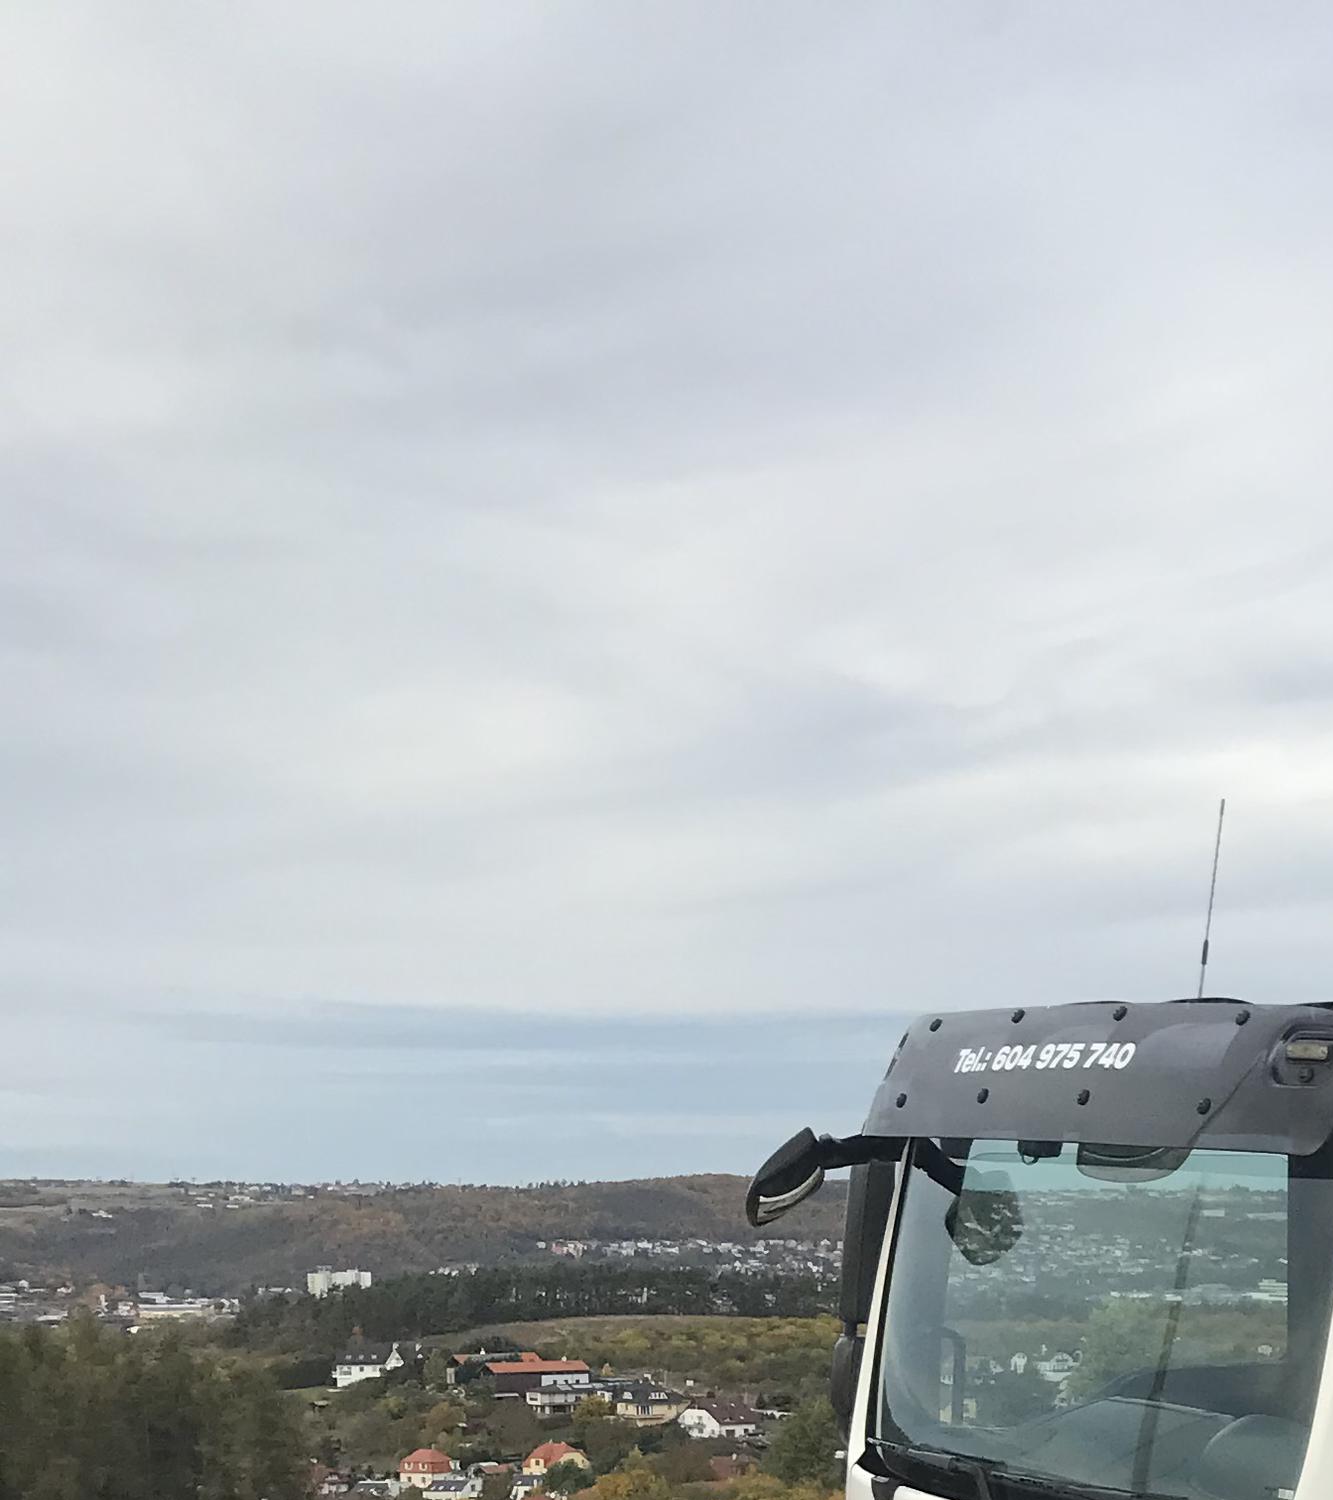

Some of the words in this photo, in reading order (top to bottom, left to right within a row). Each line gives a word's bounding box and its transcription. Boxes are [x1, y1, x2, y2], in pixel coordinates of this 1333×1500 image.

[954, 1046, 993, 1073] Tel.:
[991, 1044, 1037, 1071] 604
[1035, 1043, 1086, 1070] 975
[1083, 1042, 1136, 1070] 740
